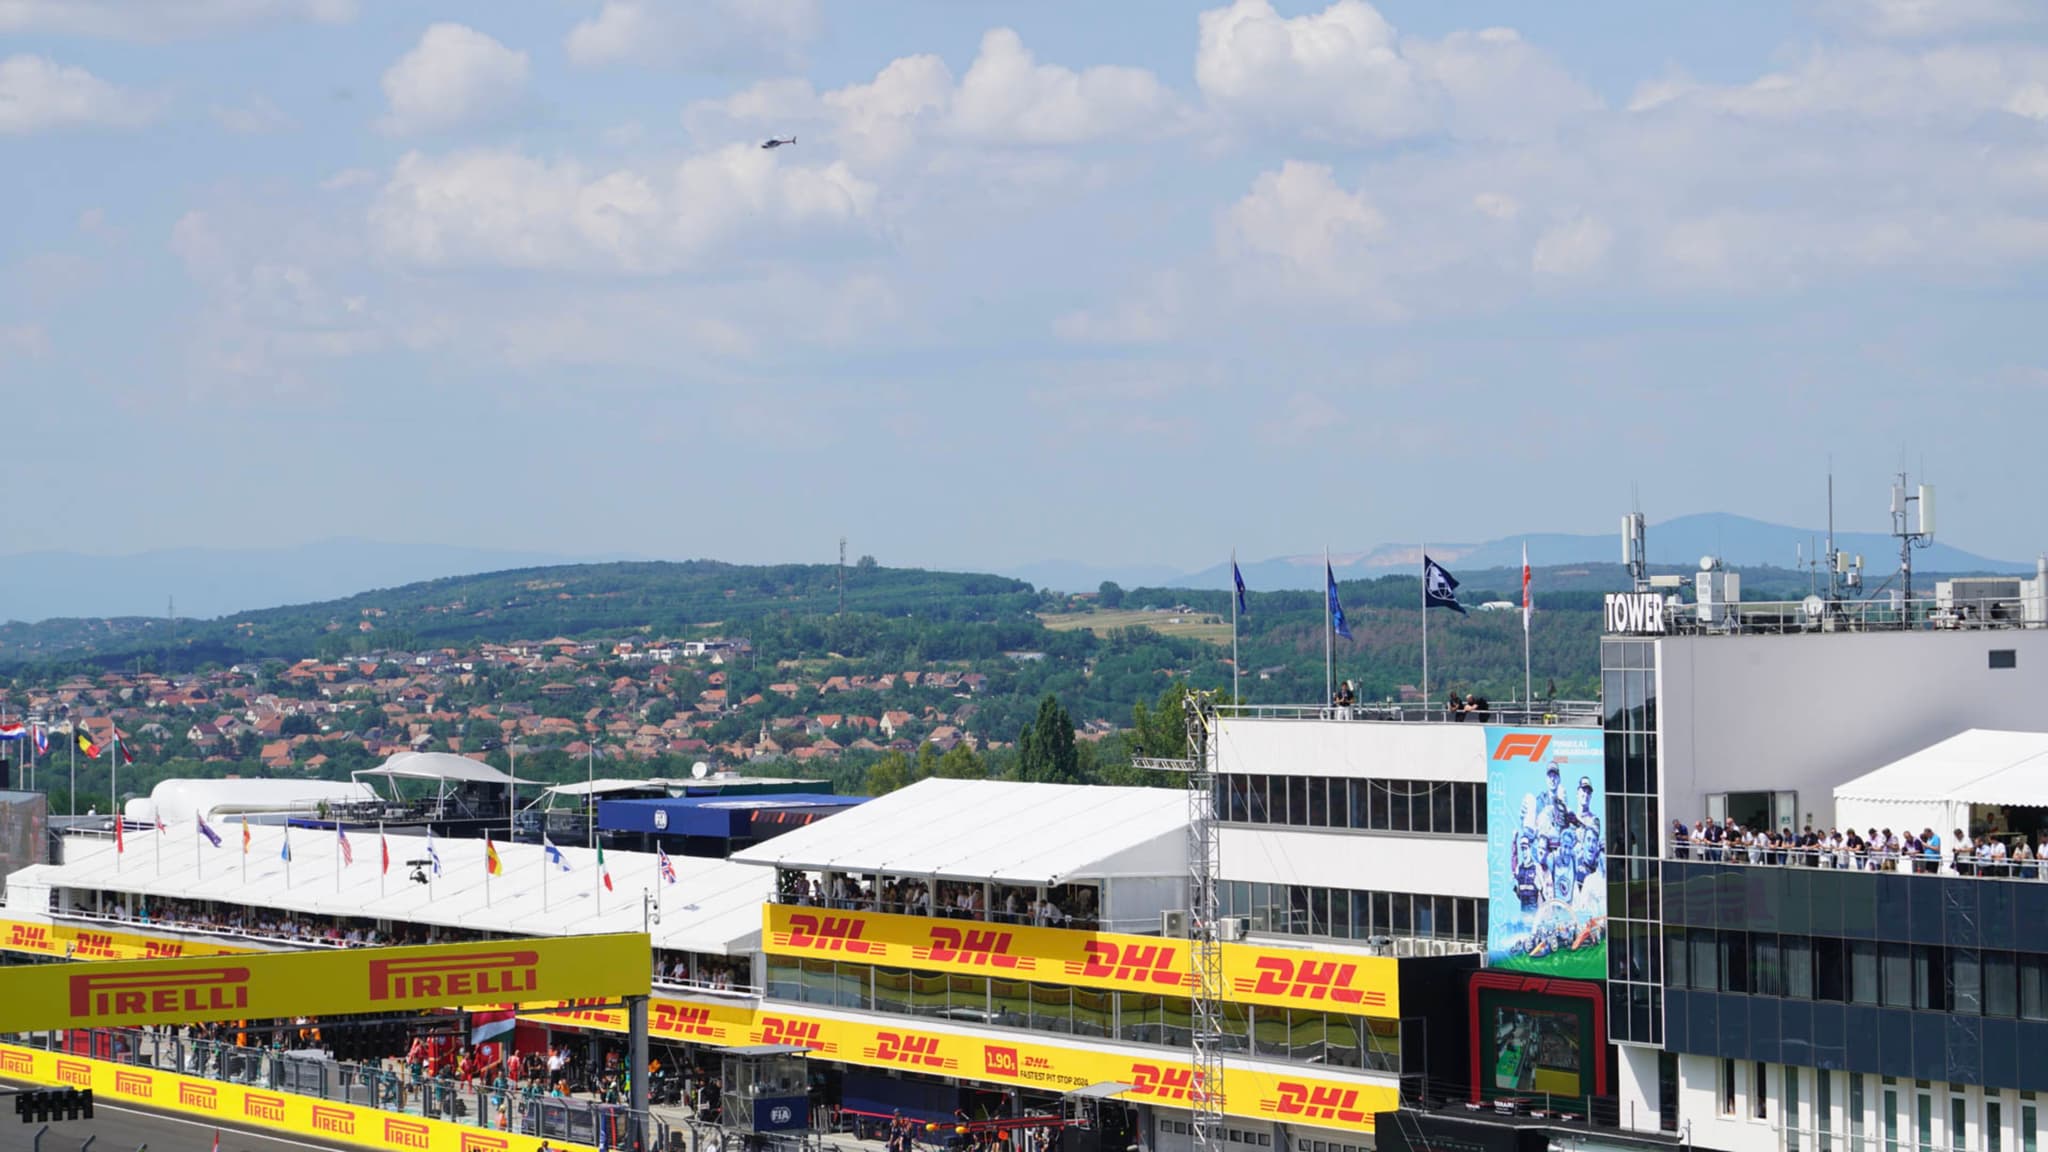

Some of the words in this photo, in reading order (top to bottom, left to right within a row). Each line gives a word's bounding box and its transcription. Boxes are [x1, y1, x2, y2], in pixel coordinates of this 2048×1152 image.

[1605, 593, 1664, 632] TOWER
[1493, 733, 1552, 762] F1
[12, 925, 48, 949] DHL
[76, 931, 115, 958] DHL
[788, 914, 871, 954] DHL
[929, 926, 1019, 968] DHL
[369, 950, 539, 1000] PIRELLI
[1083, 940, 1183, 985] DHL
[69, 967, 250, 1017] PIRELLI
[1254, 956, 1364, 1003] DHL
[655, 1004, 714, 1036] DHL
[761, 1017, 826, 1051] DHL
[0, 1050, 33, 1075] PIRELLI
[876, 1032, 945, 1067] DHL
[1024, 1056, 1050, 1069] DHL
[57, 1059, 91, 1086] PIRELLI
[116, 1071, 153, 1098] PIRELLI
[1020, 1070, 1046, 1081] FASTEST
[1046, 1073, 1056, 1082] PIT
[1057, 1075, 1073, 1084] STOP
[1131, 1063, 1213, 1101] DHL
[179, 1081, 217, 1110] PIRELLI
[244, 1092, 285, 1122] PIRELLI
[1275, 1082, 1365, 1123] DHL
[312, 1105, 355, 1135] PIRELLI
[771, 1109, 790, 1122] FIA
[384, 1118, 429, 1149] PIRELLI
